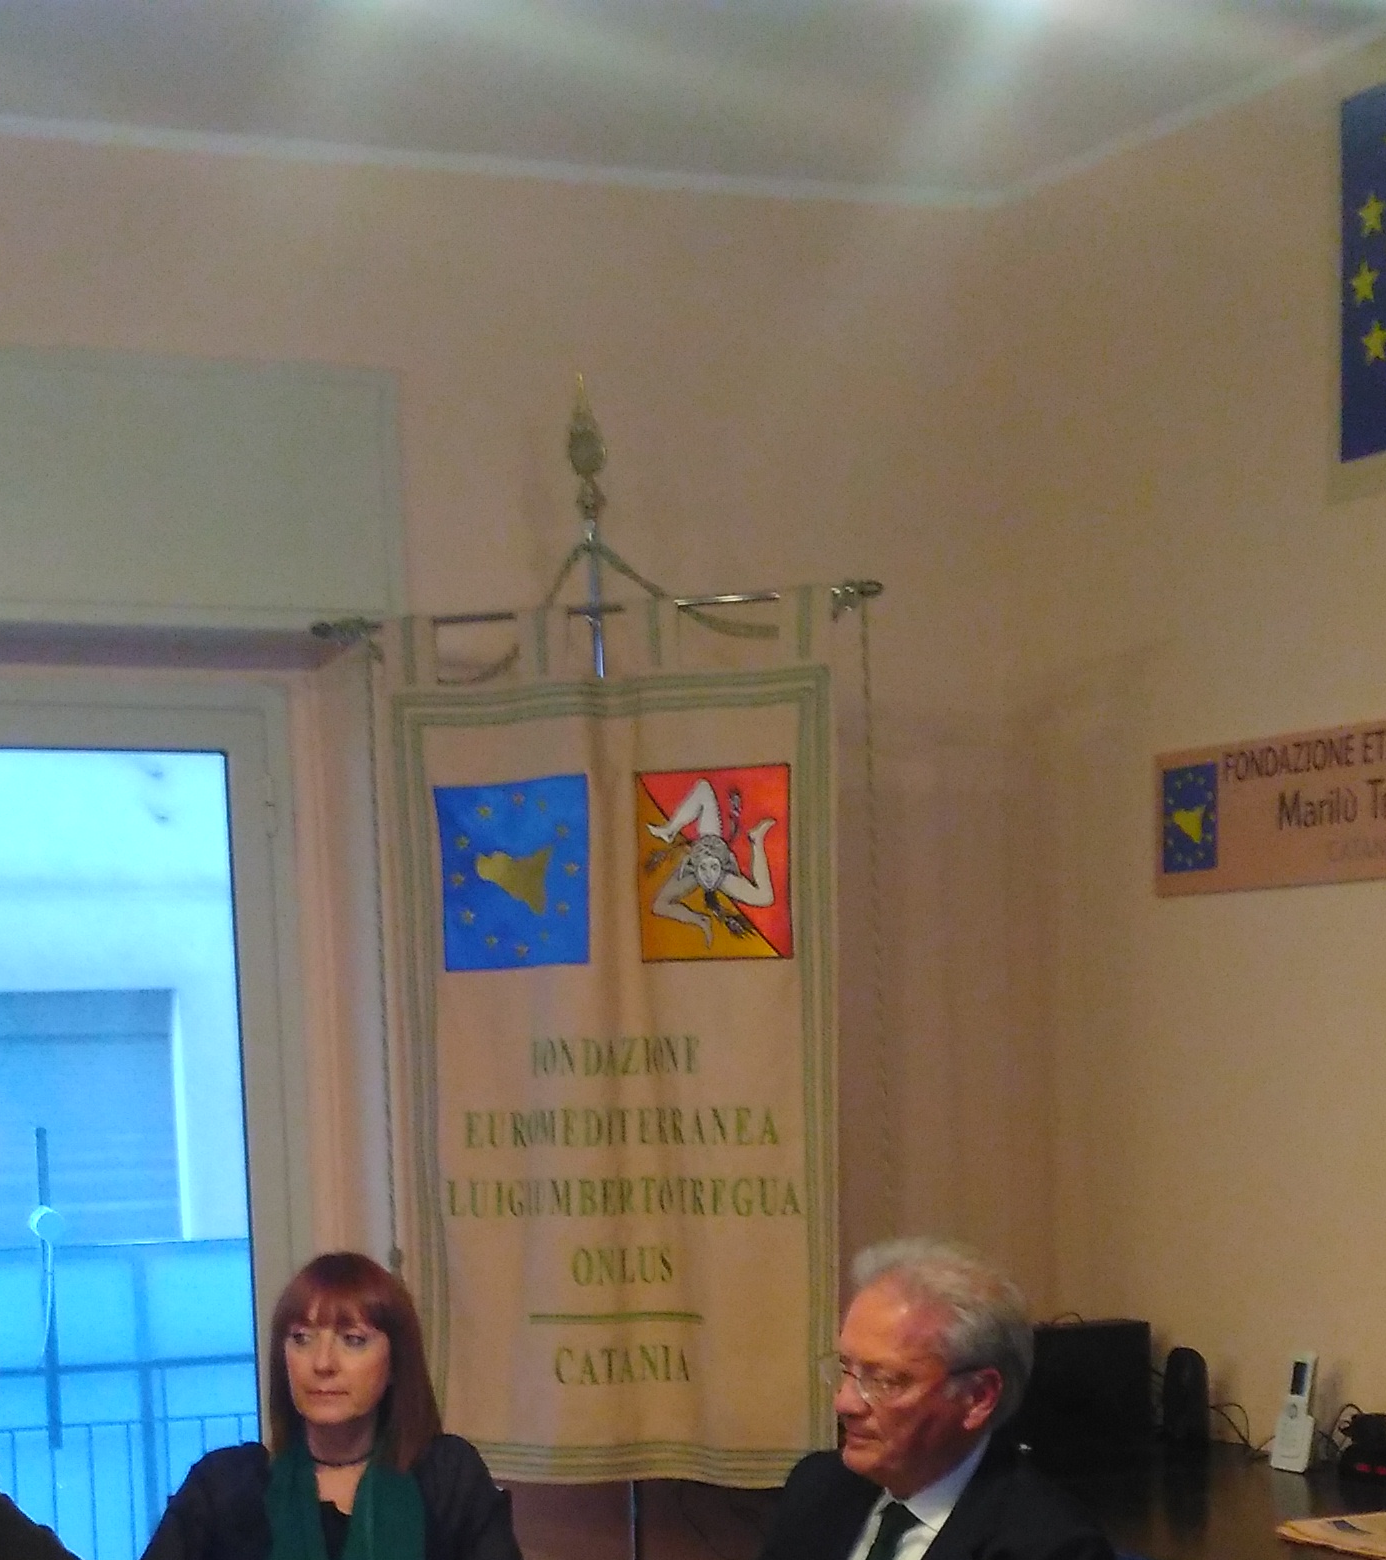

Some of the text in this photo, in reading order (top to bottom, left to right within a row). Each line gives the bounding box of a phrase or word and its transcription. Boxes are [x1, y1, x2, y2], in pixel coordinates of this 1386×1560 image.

[1221, 736, 1355, 784] FONDAZIONE
[1277, 788, 1359, 831] Marilò
[570, 1245, 674, 1287] ONLUS
[554, 1343, 691, 1386] CATANIA
